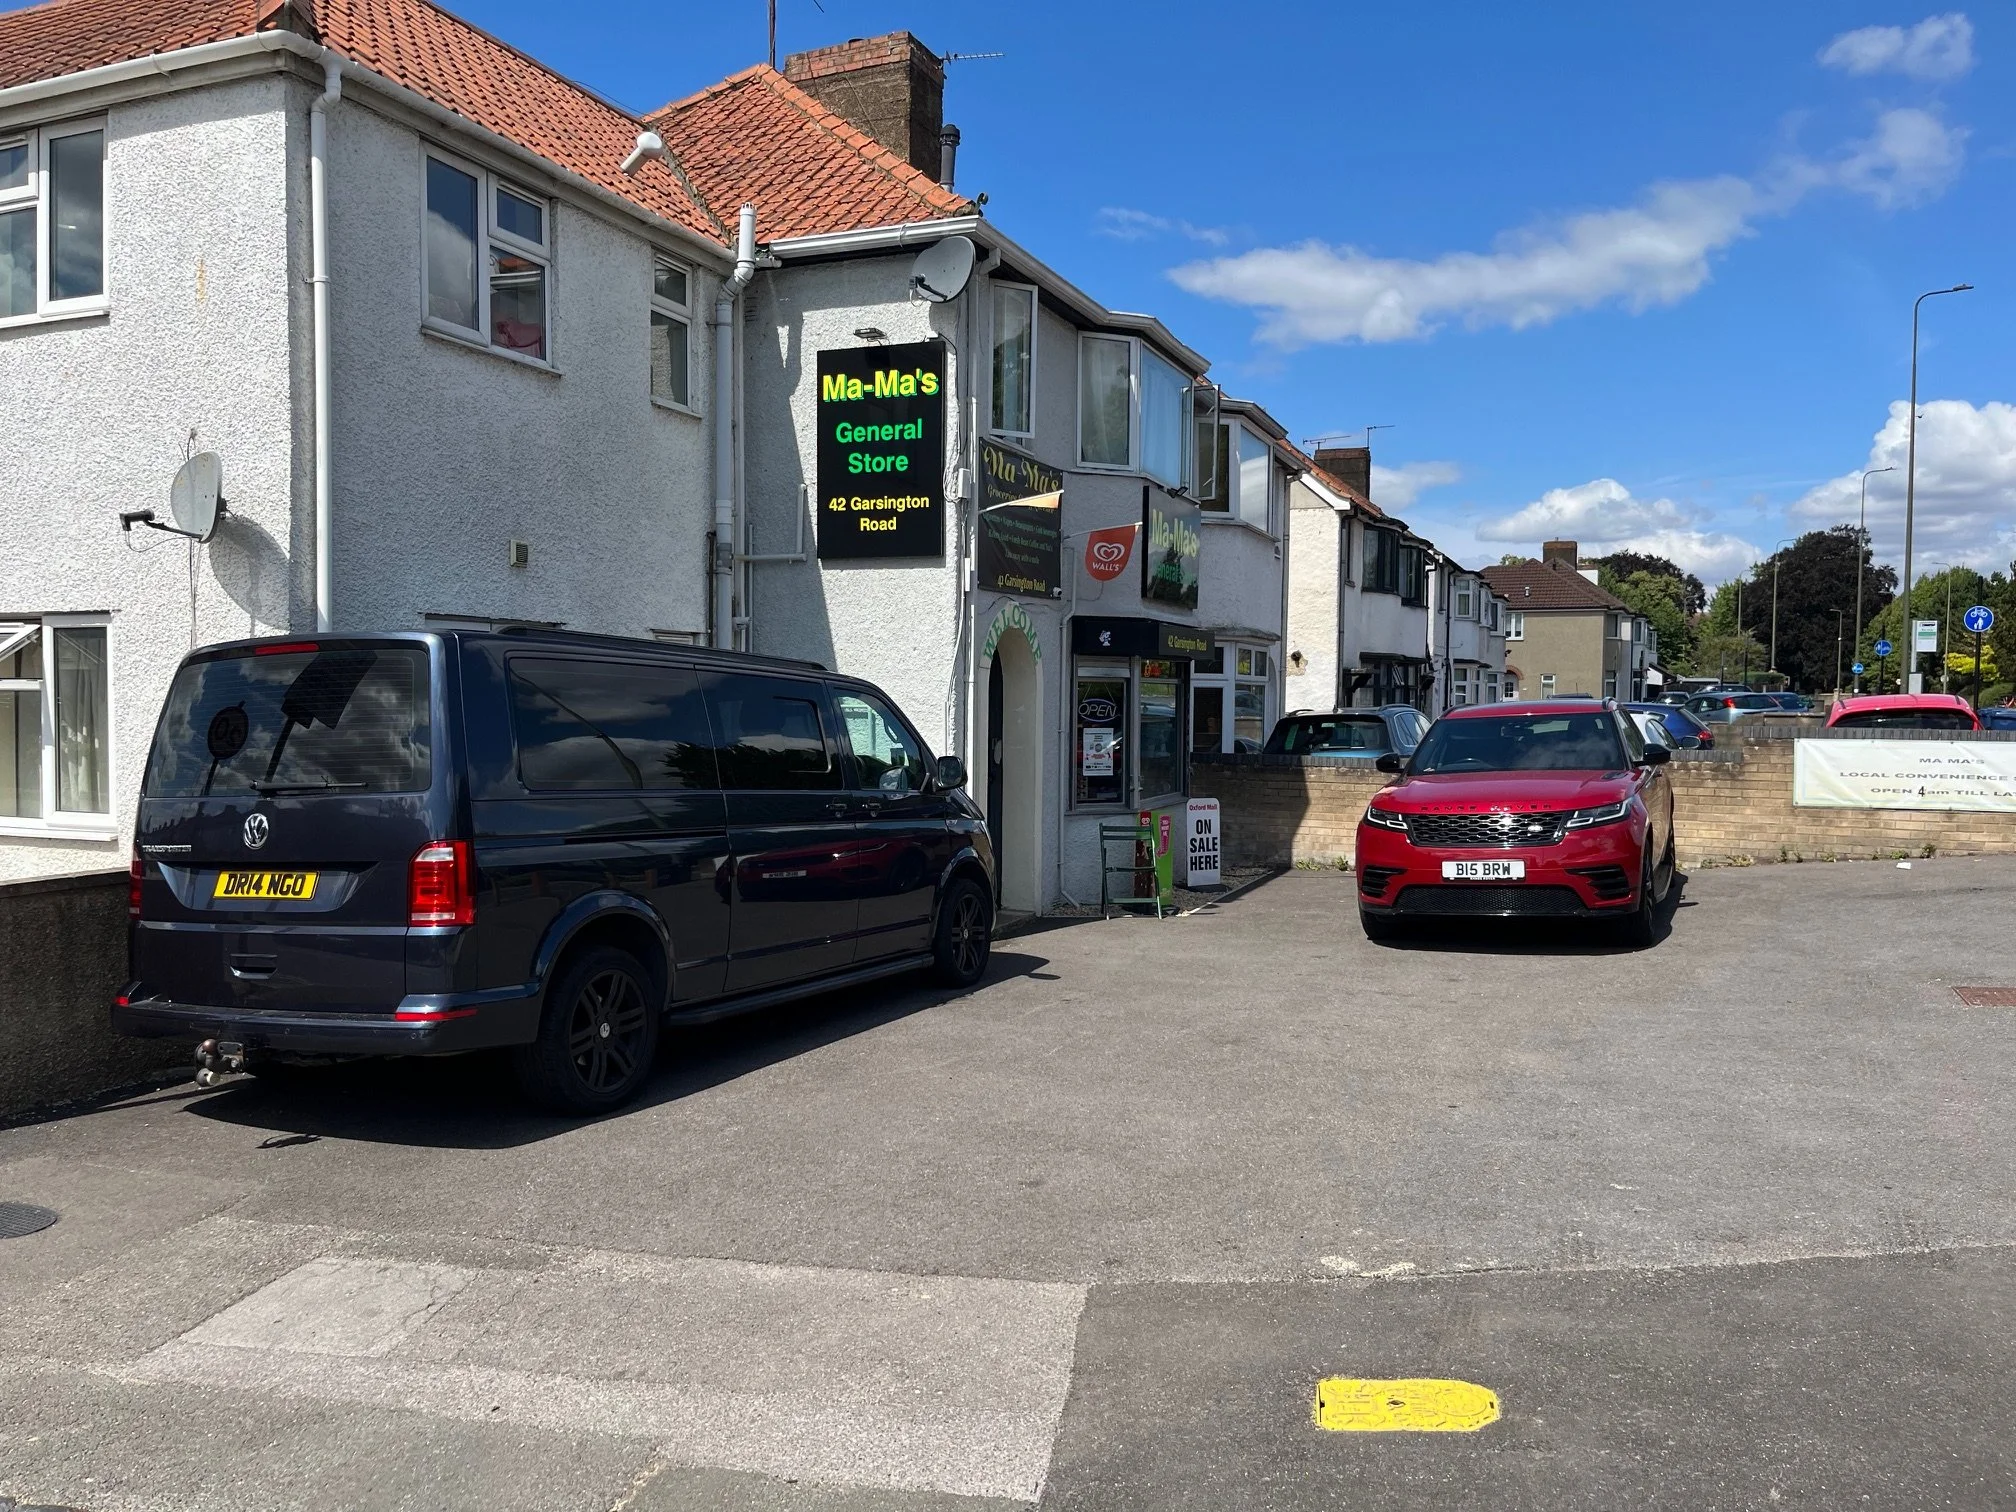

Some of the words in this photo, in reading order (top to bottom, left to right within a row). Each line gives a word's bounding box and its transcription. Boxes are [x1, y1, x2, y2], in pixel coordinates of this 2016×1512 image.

[822, 368, 939, 403] Ma-Ma's
[835, 418, 923, 443] General
[848, 452, 909, 474] Store
[828, 497, 847, 511] 42
[850, 495, 930, 512] Garsington
[859, 517, 897, 531] Road
[1152, 508, 1197, 558] Ma-Ma's
[1092, 562, 1119, 572] WALL'S
[1004, 573, 1033, 592] Garsington
[1033, 578, 1046, 592] Road
[983, 604, 1042, 665] WELCOME
[1196, 638, 1207, 651] Road
[1078, 702, 1117, 717] OPEN
[1894, 773, 2008, 781] CONVENIENCE
[1195, 819, 1212, 834] ON
[1189, 836, 1218, 853] SALE
[1190, 854, 1219, 871] HERE
[1482, 862, 1511, 876] BRW
[223, 873, 264, 896] DR14
[266, 872, 307, 896] NGO
